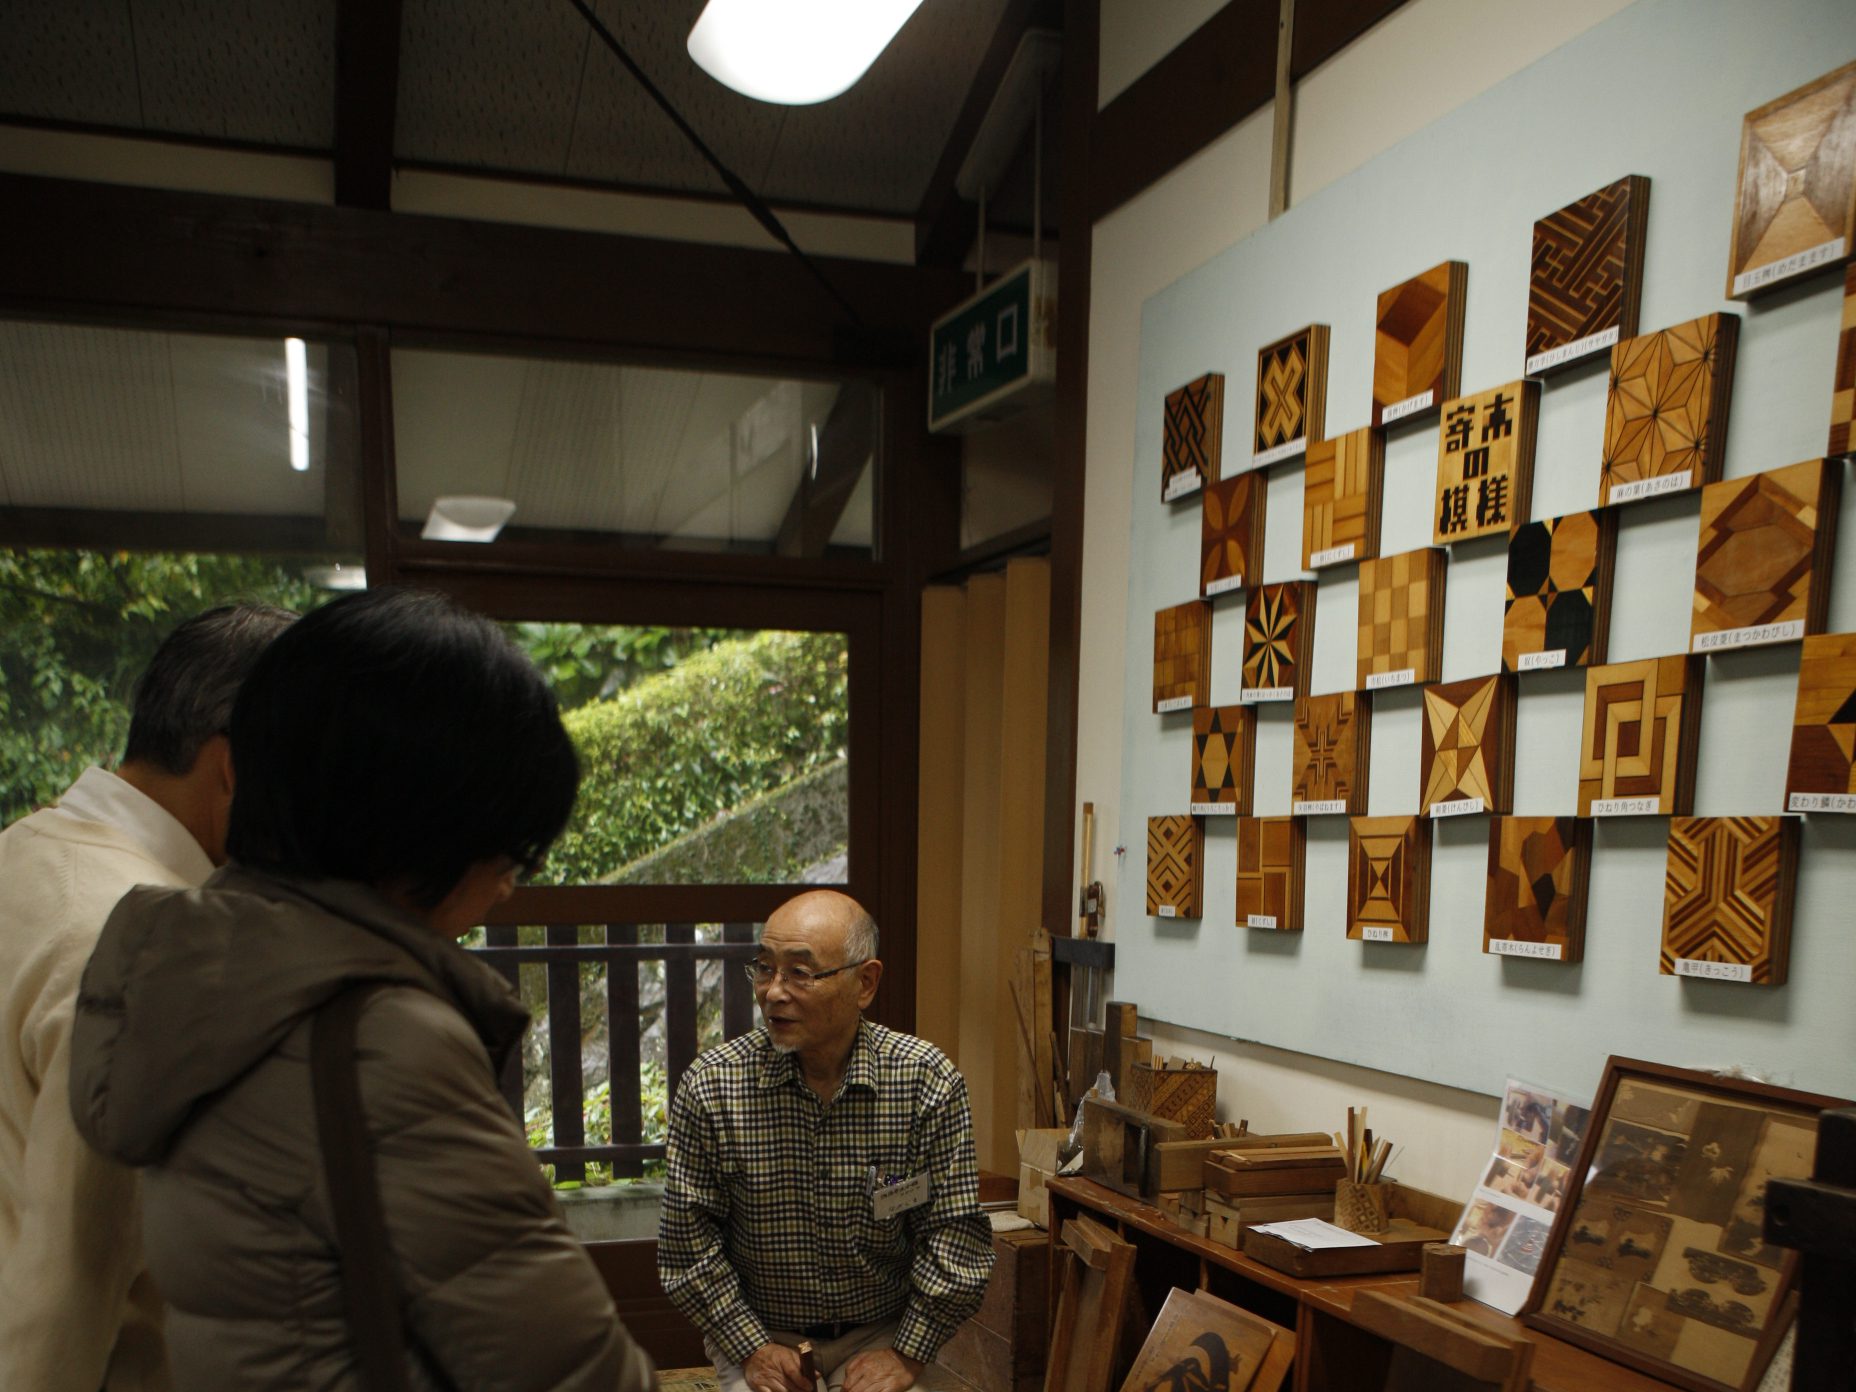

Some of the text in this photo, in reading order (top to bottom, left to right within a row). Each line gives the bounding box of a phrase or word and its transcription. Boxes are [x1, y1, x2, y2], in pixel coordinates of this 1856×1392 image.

[1701, 623, 1796, 648] 松皮菱(まつかわびし)
[1598, 800, 1653, 812] ひねり角つなぎ
